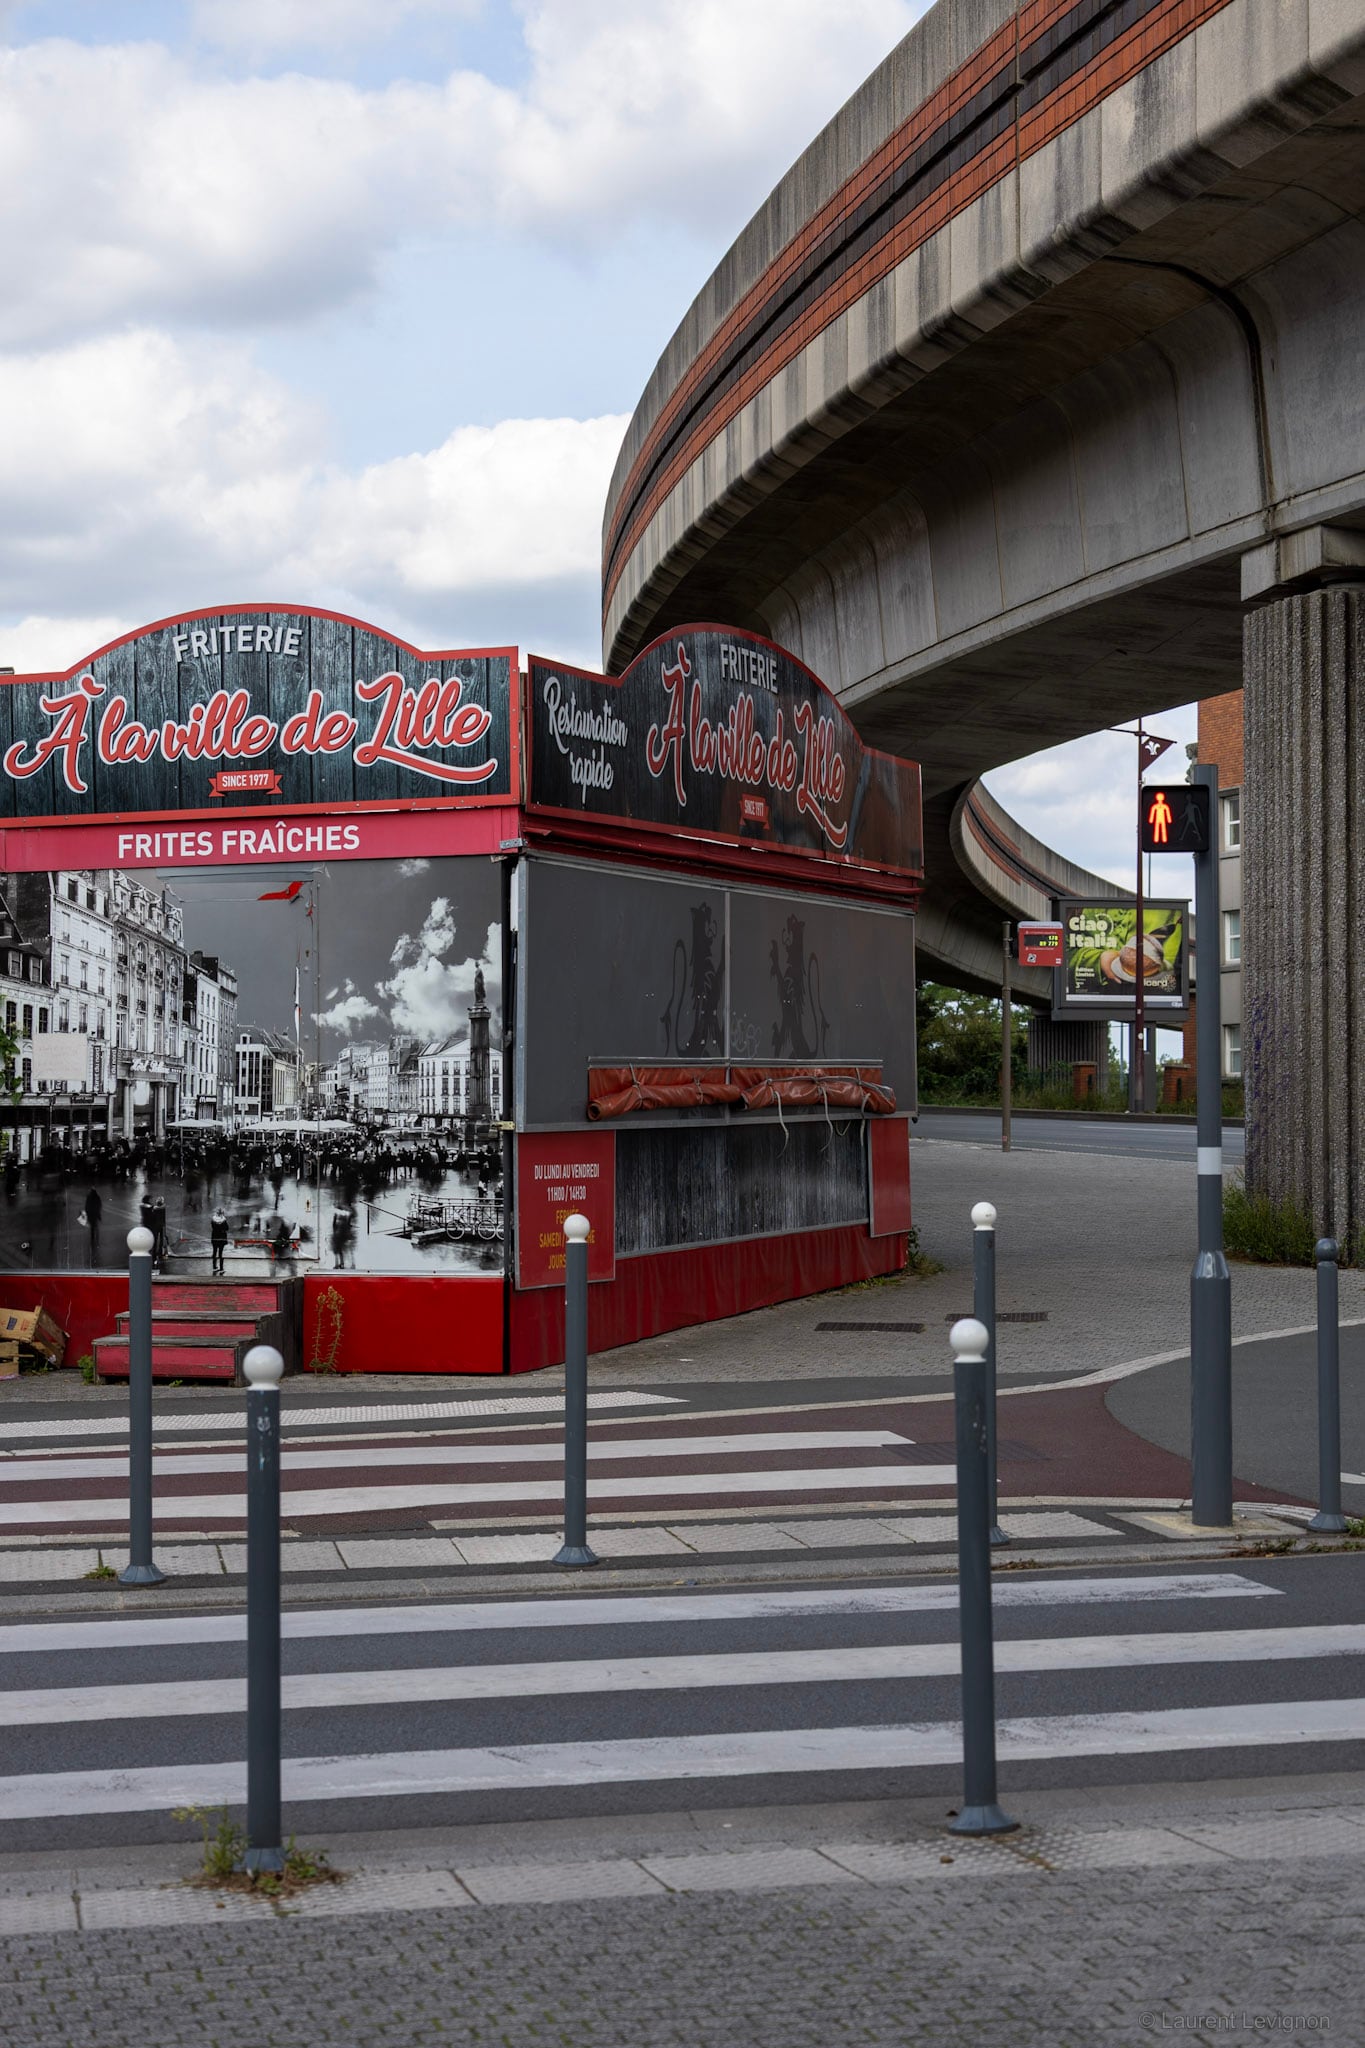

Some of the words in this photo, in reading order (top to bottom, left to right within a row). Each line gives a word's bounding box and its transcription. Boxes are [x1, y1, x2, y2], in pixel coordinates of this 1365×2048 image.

[171, 625, 303, 662] FRITERIE
[720, 643, 779, 694] FRITERIE
[3, 674, 107, 794] À
[99, 694, 159, 764] la
[159, 688, 278, 761] ville
[281, 688, 357, 755] de
[353, 671, 498, 783] Lille
[543, 675, 629, 755] Restauration
[222, 774, 247, 787] SINCE
[249, 773, 269, 786] 1977
[569, 745, 614, 806] rapide
[689, 679, 716, 775] la
[716, 691, 766, 786] ville
[766, 707, 797, 792] de
[794, 700, 847, 848] Lille
[118, 829, 214, 859] FRITES
[221, 821, 360, 856] FRAÎCHES
[1069, 914, 1108, 931] Ciao
[1069, 931, 1118, 948] Italia
[534, 1164, 543, 1180] DU
[543, 1164, 562, 1179] LUNDI
[562, 1164, 571, 1179] AU
[571, 1163, 600, 1179] VENDREDI
[547, 1186, 565, 1202] 11H00
[565, 1184, 569, 1202] /
[569, 1185, 587, 1201] 14H30
[539, 1232, 562, 1248] SAMEDI
